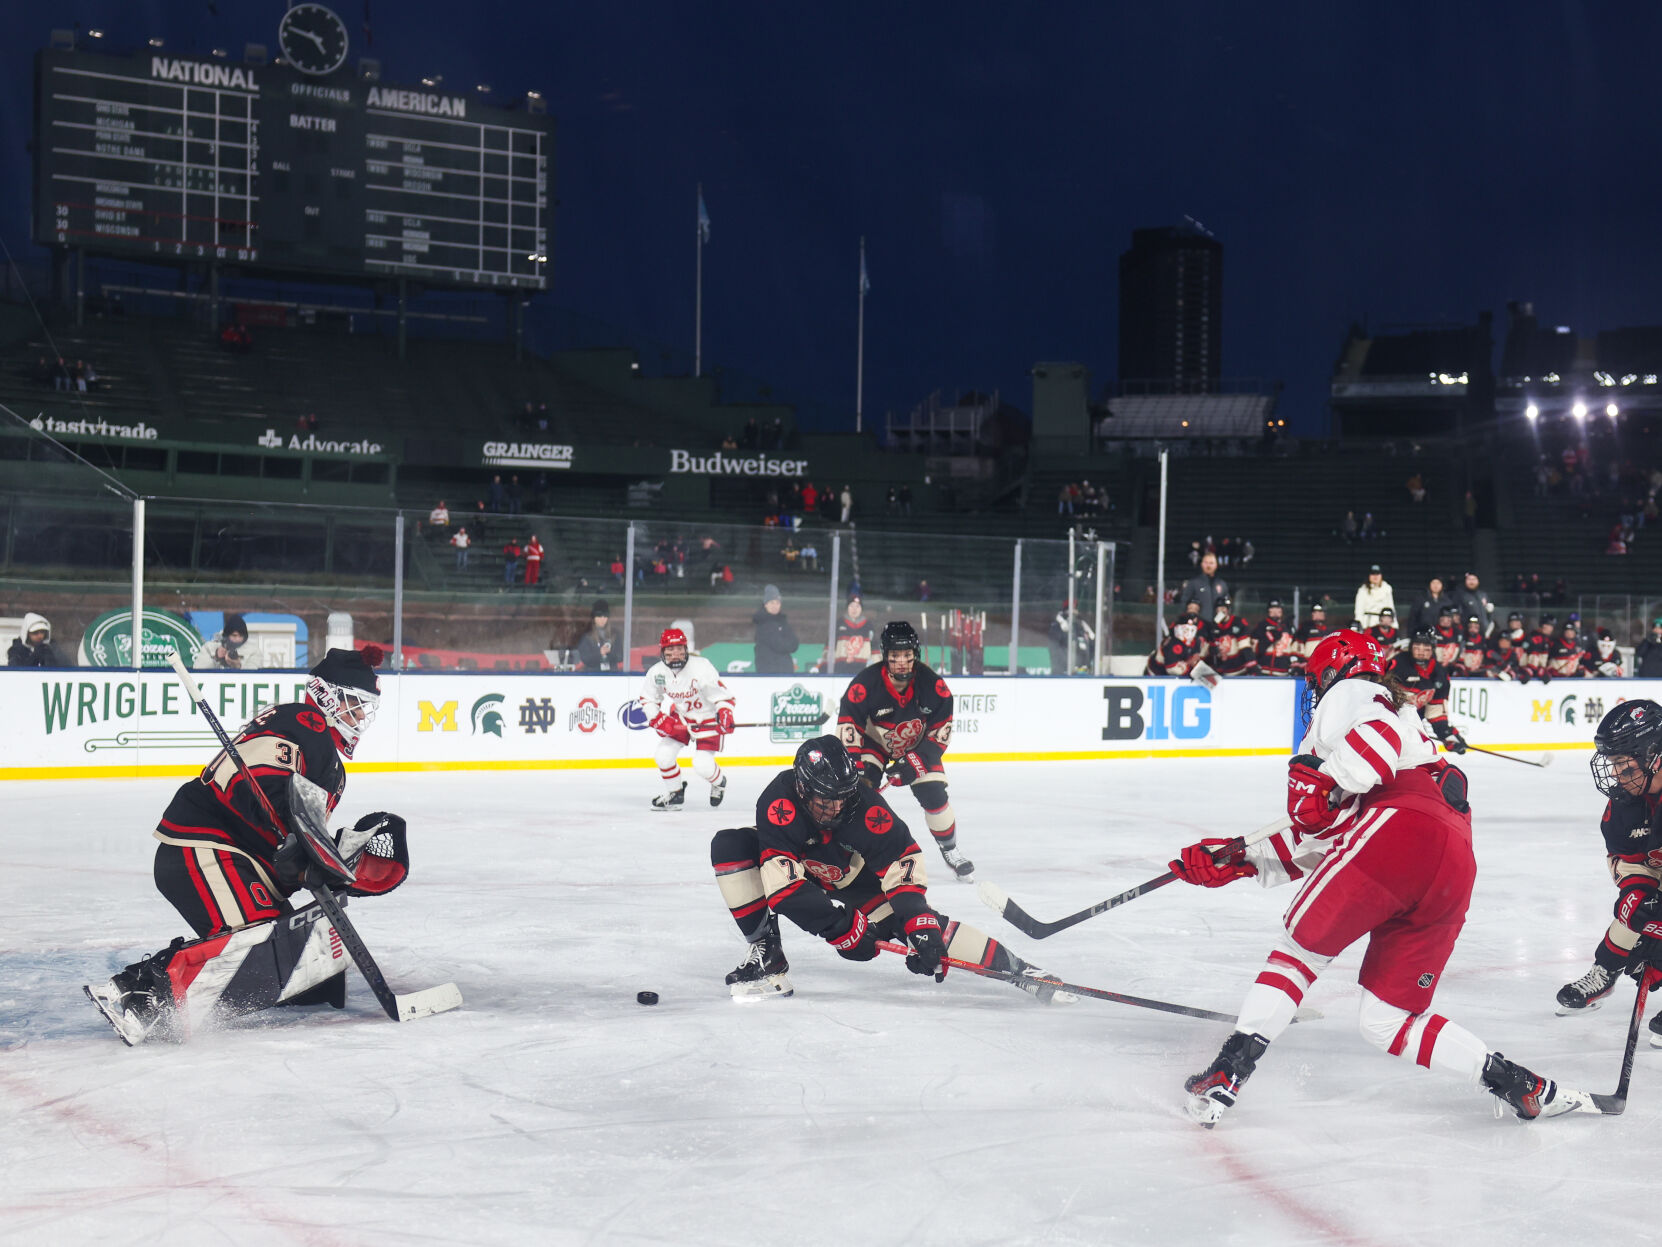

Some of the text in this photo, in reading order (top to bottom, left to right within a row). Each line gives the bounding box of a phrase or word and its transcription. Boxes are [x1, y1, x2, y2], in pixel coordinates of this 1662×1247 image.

[152, 56, 260, 91] NATIONAL
[291, 82, 350, 101] OFFICIALS
[366, 86, 466, 117] AMERICAN
[289, 114, 336, 132] BATTER
[273, 161, 290, 171] BALL
[304, 206, 320, 216] OUT
[45, 416, 158, 440] tastytrade
[288, 434, 383, 455] Advocate
[483, 441, 573, 460] GRAINGER
[670, 449, 808, 477] Budweiser
[118, 638, 174, 654] Fozen
[42, 682, 204, 735] WRIGLEY
[417, 700, 458, 732] M
[684, 699, 703, 713] 26
[774, 695, 820, 715] Frozen
[1452, 687, 1488, 723] IELD
[1530, 699, 1553, 722] M
[1288, 776, 1316, 795] CM
[780, 858, 797, 882] 7
[900, 858, 916, 884] 7
[1090, 886, 1141, 918] CCM
[1619, 892, 1638, 928] UER
[288, 903, 328, 931] CC
[916, 916, 940, 927] BA
[328, 926, 344, 960] OHIO
